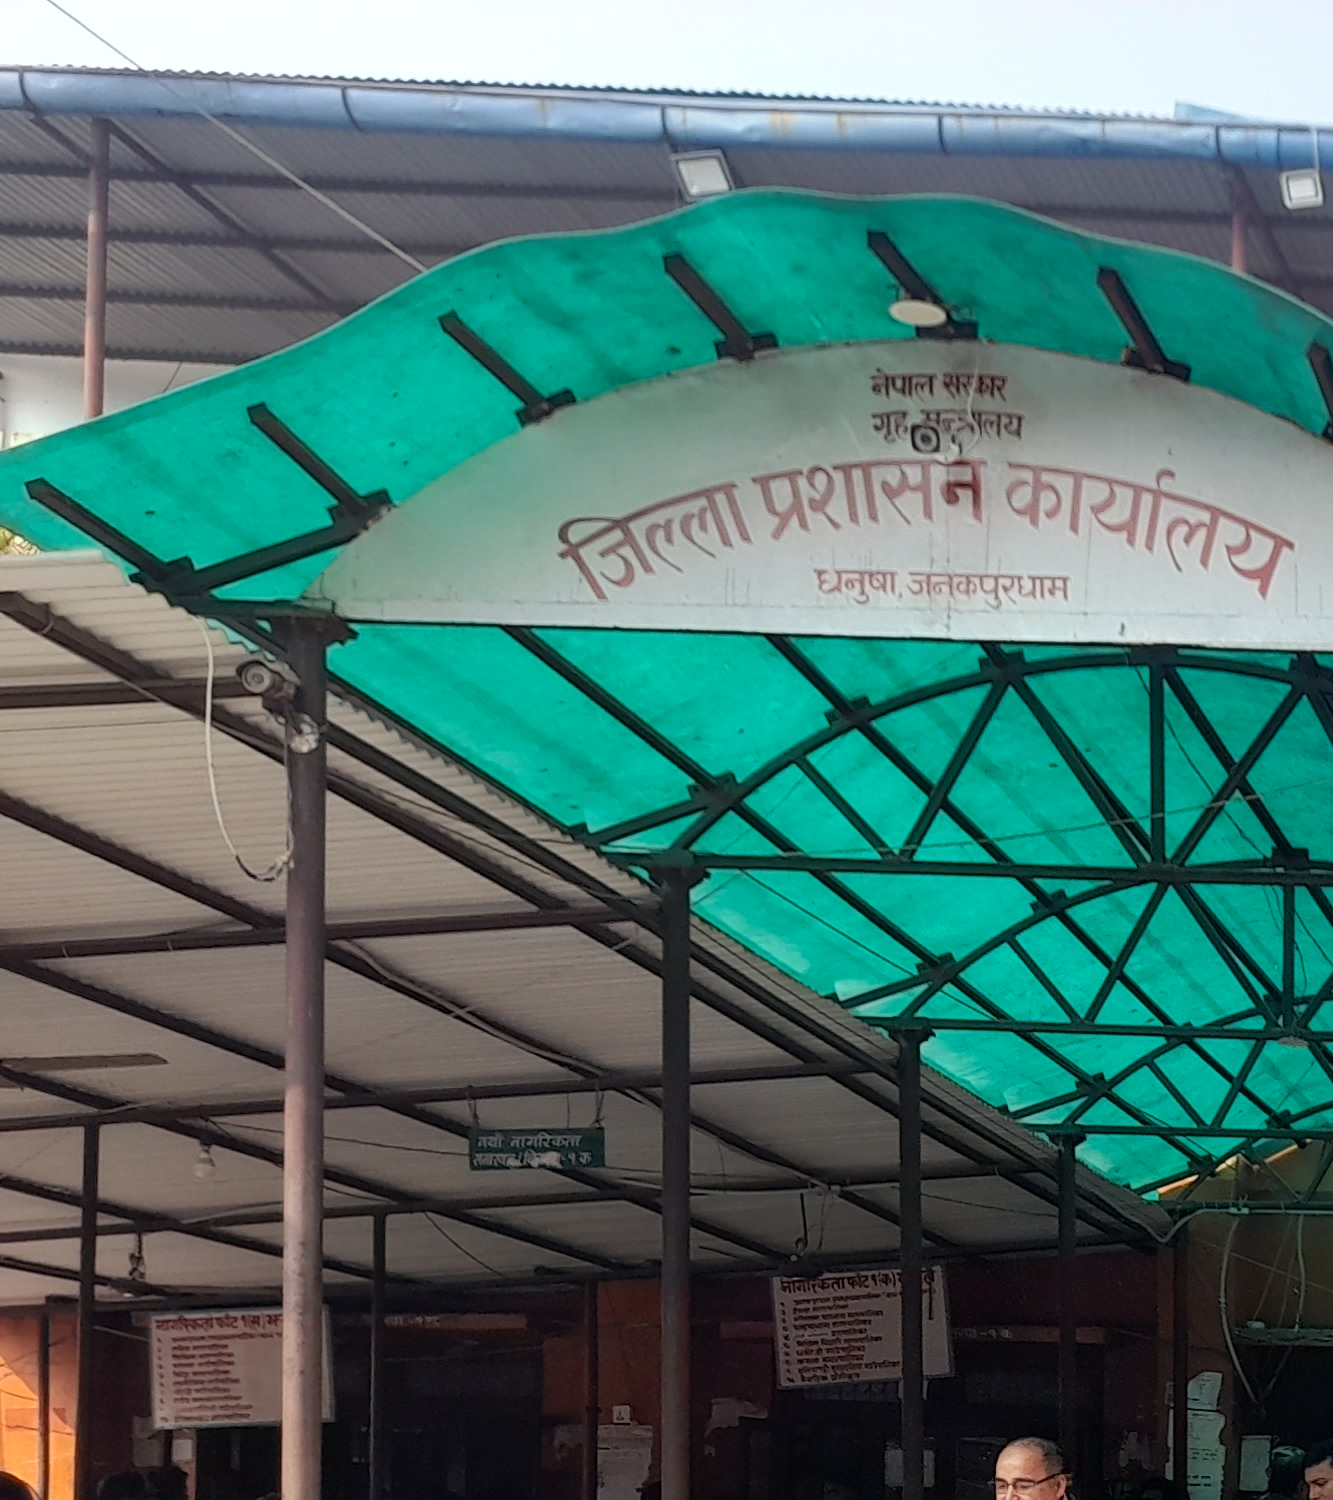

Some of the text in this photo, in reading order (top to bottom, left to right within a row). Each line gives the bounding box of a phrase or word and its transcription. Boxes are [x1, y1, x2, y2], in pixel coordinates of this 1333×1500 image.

[871, 368, 1008, 402] नेपाल सरकार
[872, 409, 909, 444] गृह
[558, 457, 1295, 600] जिल्ला प्रशासन कार्यालय
[907, 571, 1070, 610] जनकपुरधाम
